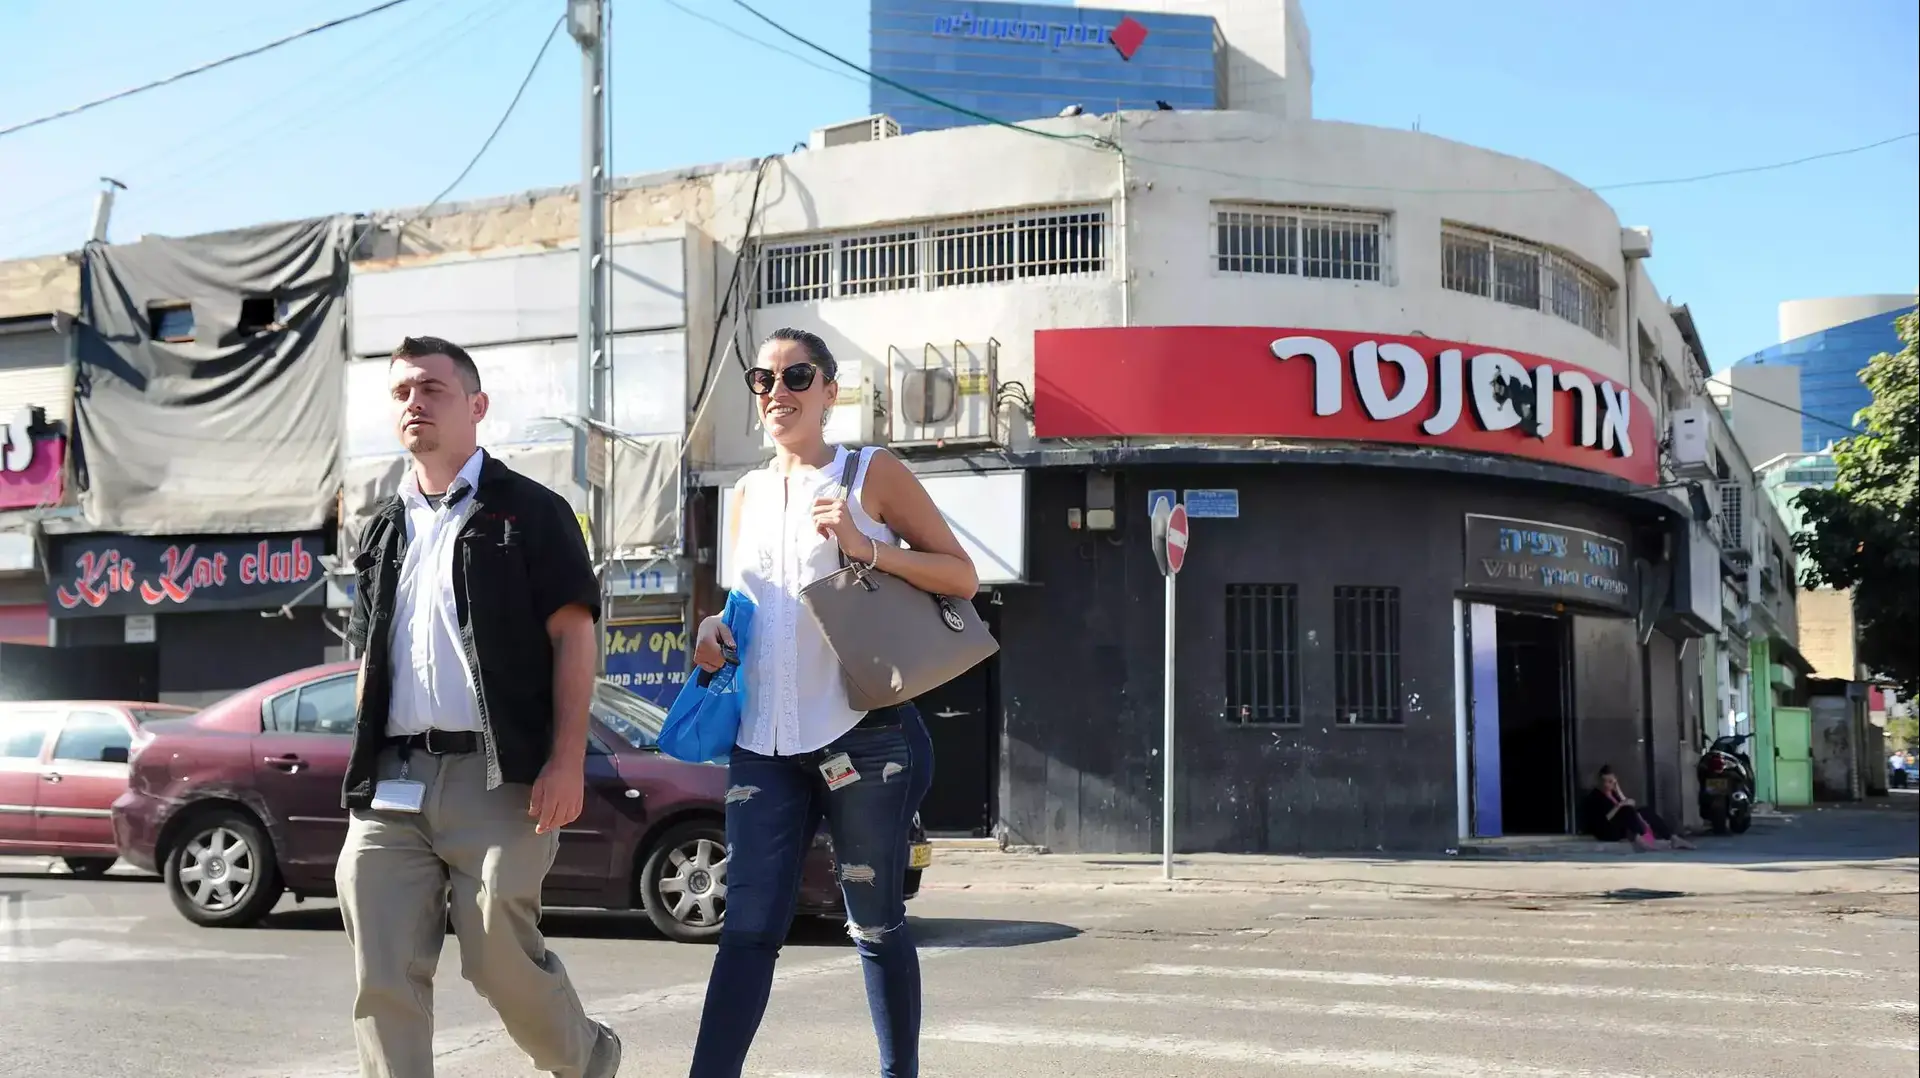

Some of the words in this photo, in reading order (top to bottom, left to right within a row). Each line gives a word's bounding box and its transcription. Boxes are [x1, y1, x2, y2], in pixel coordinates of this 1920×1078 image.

[934, 12, 1048, 40] הפועלים
[1051, 24, 1109, 48] בנק
[1271, 336, 1634, 459] ארוסנטר
[1498, 527, 1570, 557] צפיה
[57, 549, 136, 608] Kit
[140, 543, 229, 605] Kat
[239, 537, 313, 585] club
[947, 612, 962, 629] MK
[634, 672, 664, 685] צפיה
